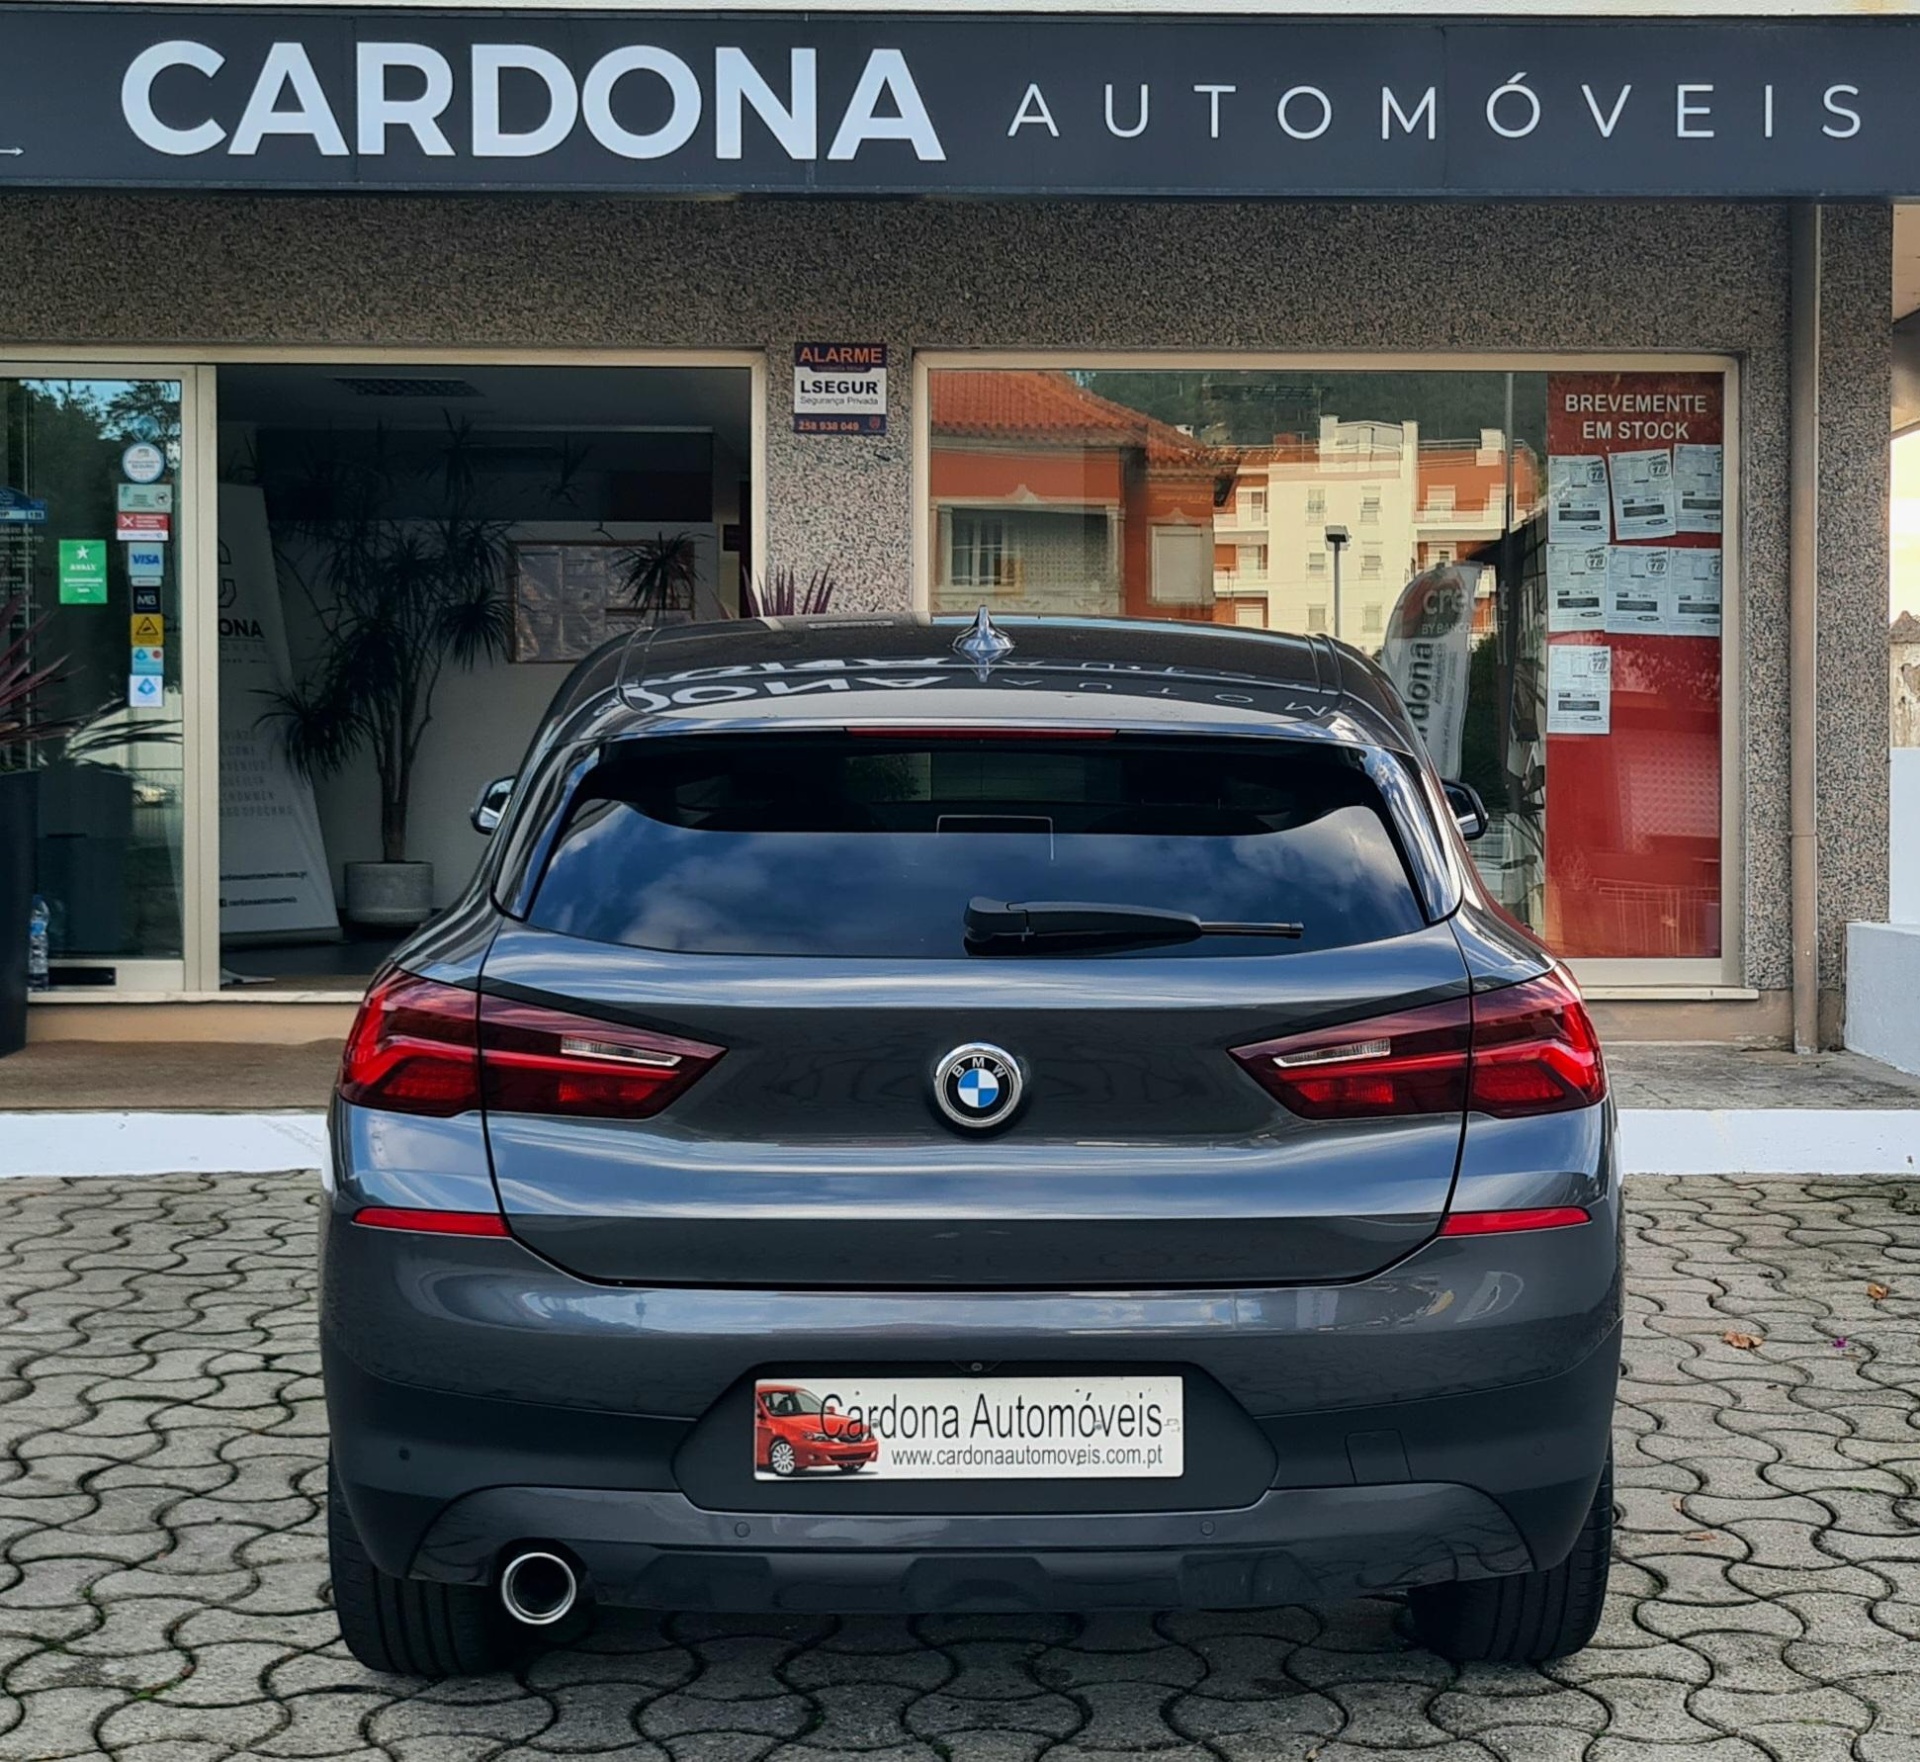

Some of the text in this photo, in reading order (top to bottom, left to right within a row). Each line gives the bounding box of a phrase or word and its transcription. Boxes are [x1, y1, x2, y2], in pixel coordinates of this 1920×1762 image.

[121, 39, 1861, 160] CARDONA AUTOMÓVEIS
[800, 346, 882, 364] ALARME
[800, 380, 878, 395] LSEGUR
[800, 396, 879, 406] Segurança Privada
[1565, 394, 1707, 412] BREVEMENTE
[1583, 421, 1689, 439] EM STOCK
[132, 554, 160, 564] VISA
[951, 1057, 1006, 1078] BMW
[820, 1392, 1162, 1439] Cardona Automóveis
[892, 1444, 1163, 1469] www.cardonaautomoveis.com.pt
